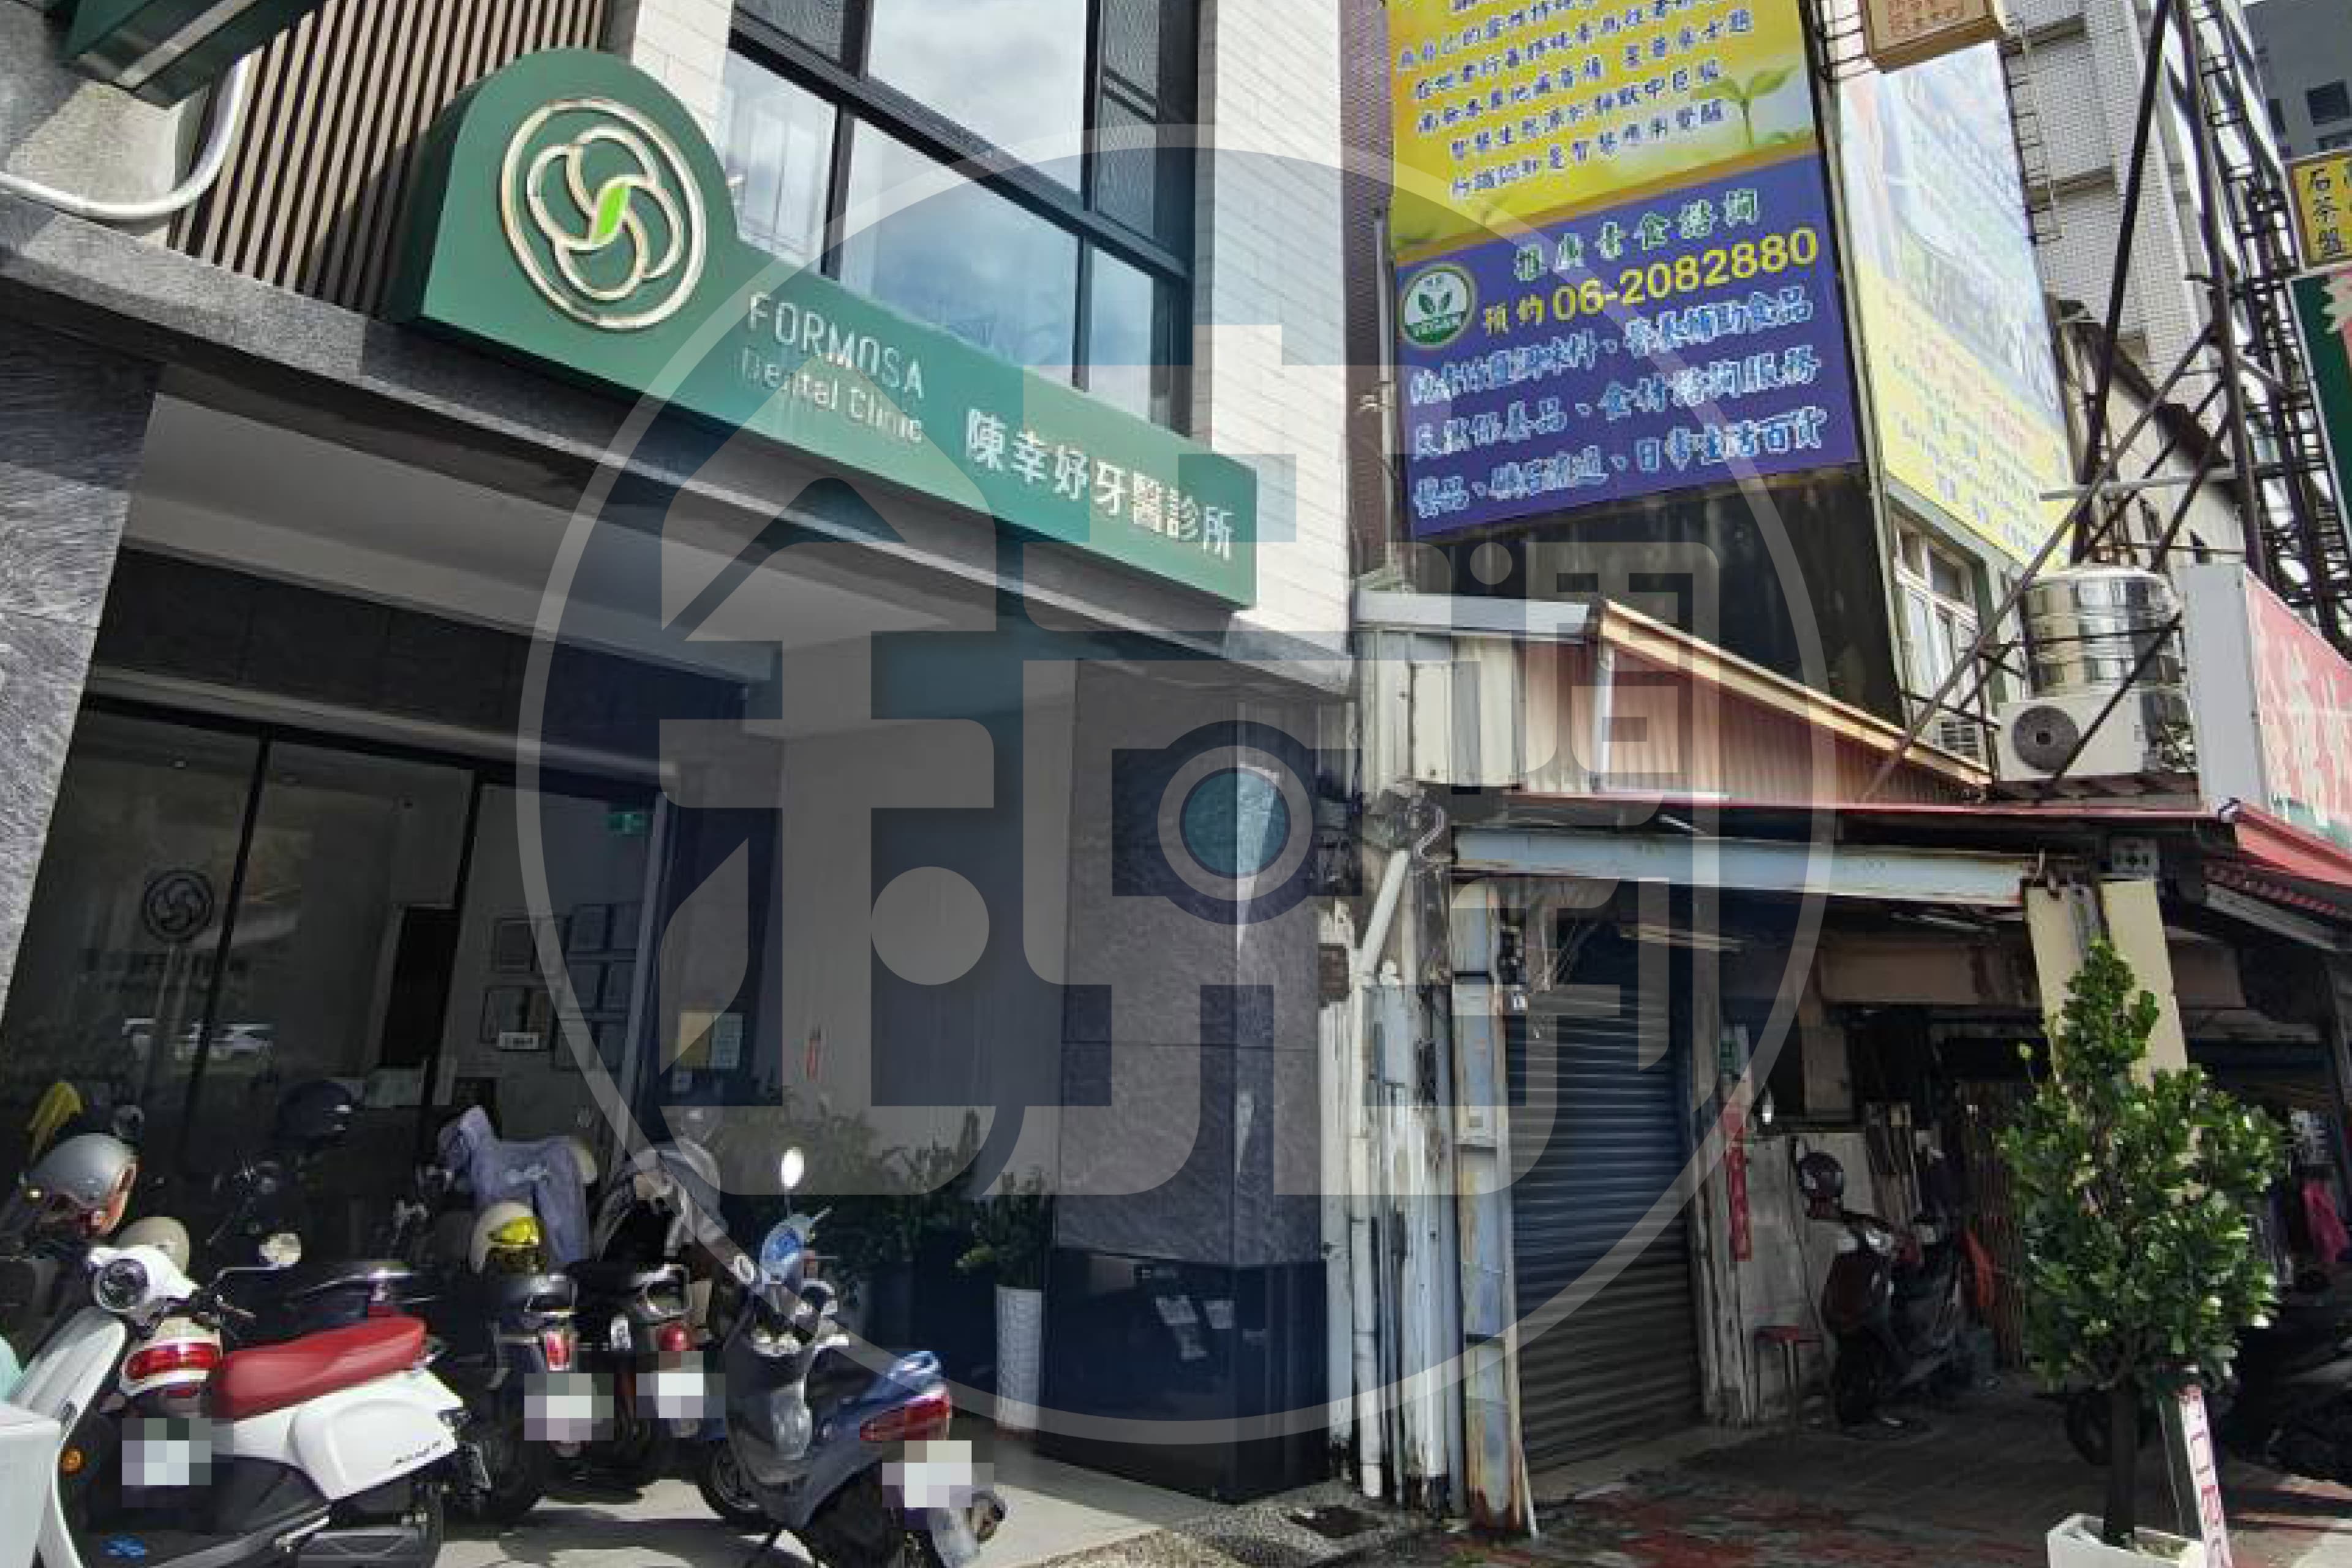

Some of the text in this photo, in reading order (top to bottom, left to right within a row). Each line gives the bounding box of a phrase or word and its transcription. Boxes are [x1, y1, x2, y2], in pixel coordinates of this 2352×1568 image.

[1482, 226, 1819, 337] 預約 06-2082880
[742, 346, 924, 443] Dental Clinic
[748, 293, 925, 399] FORMOSA
[965, 409, 1233, 561] 陳幸妤牙醫診所
